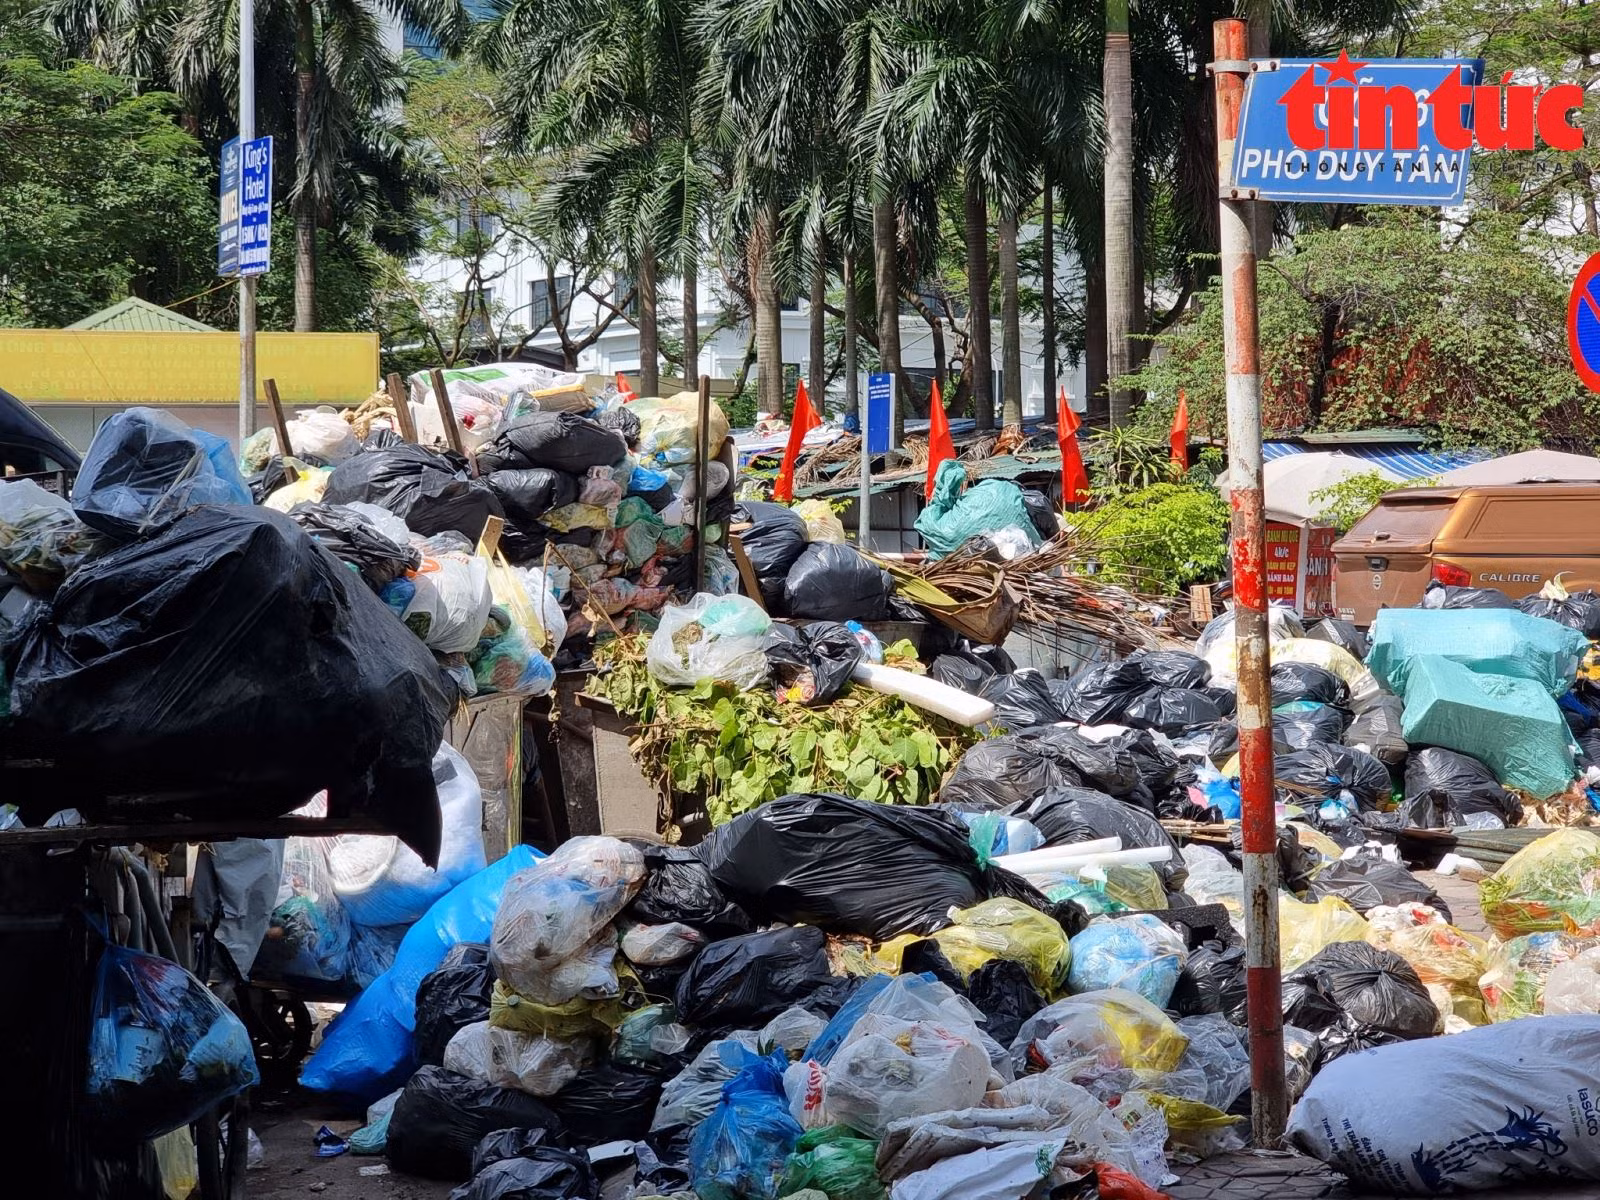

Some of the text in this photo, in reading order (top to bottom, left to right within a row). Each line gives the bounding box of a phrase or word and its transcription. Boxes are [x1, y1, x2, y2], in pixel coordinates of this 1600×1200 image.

[244, 142, 268, 174] King's
[1315, 151, 1384, 182] DUY
[1392, 144, 1459, 184] TÂN
[244, 173, 266, 201] Hotel
[1479, 572, 1541, 583] CALIBRE
[1577, 1088, 1599, 1137] lasuco
